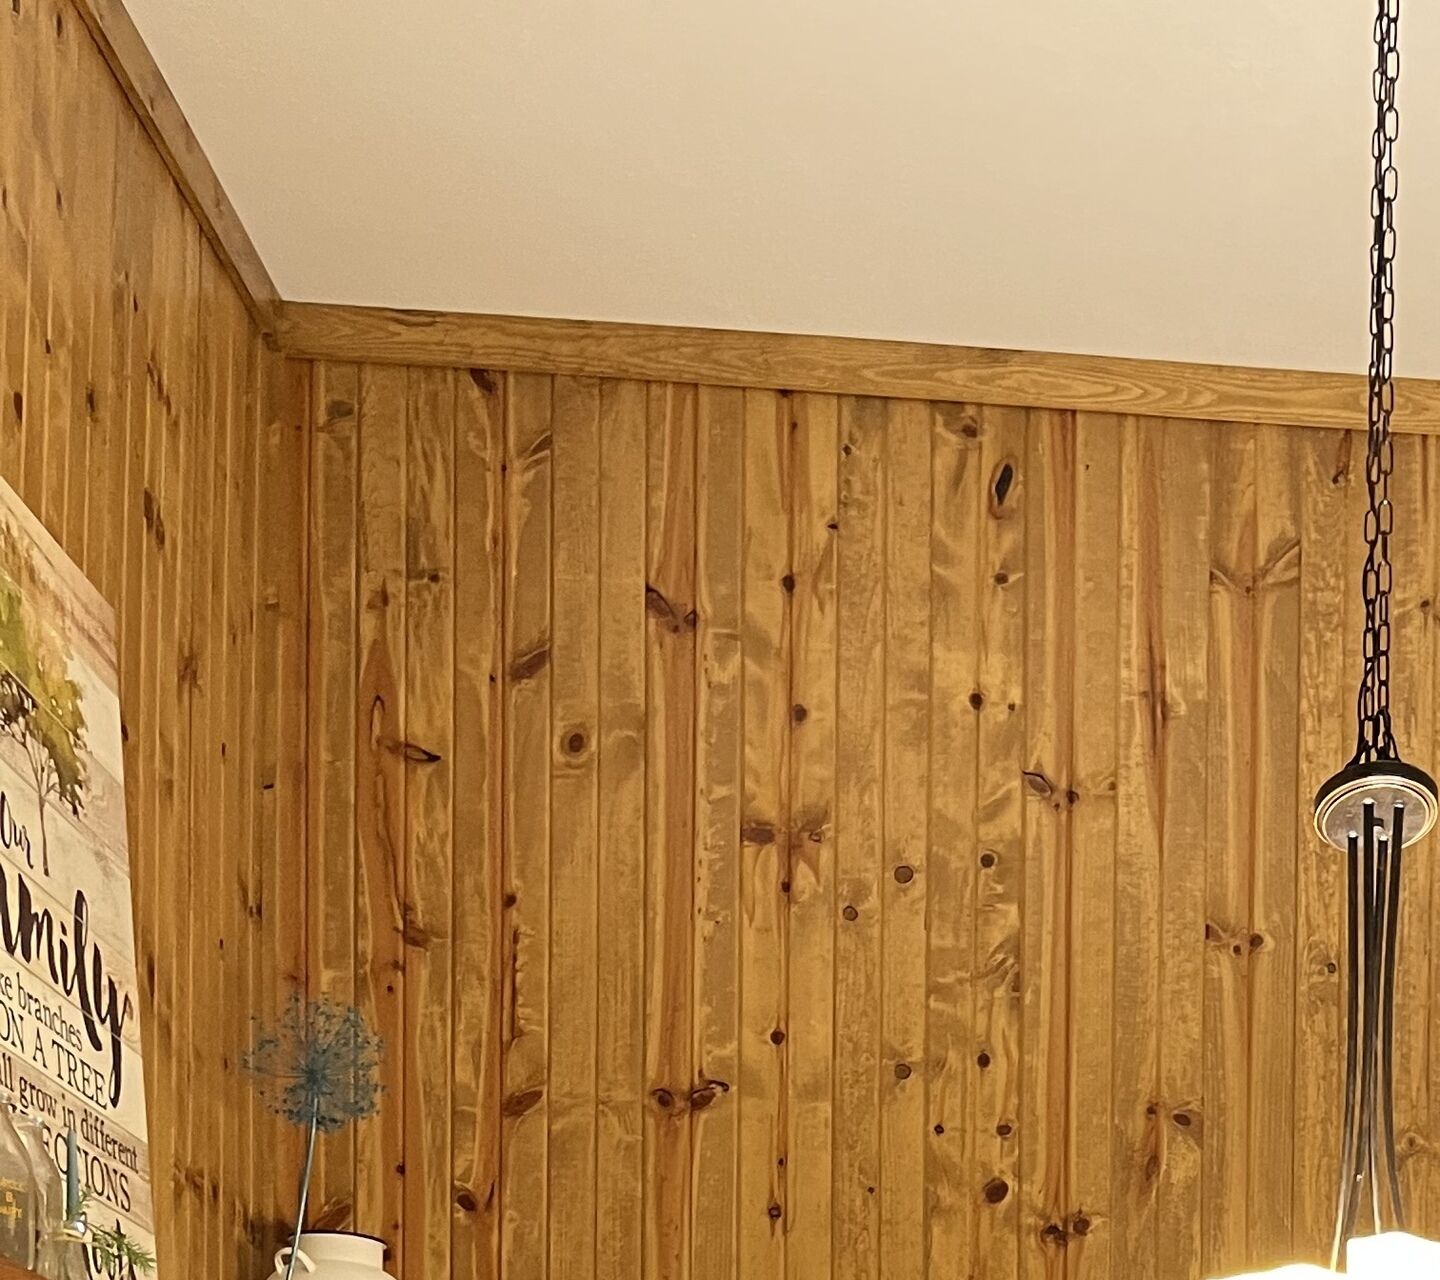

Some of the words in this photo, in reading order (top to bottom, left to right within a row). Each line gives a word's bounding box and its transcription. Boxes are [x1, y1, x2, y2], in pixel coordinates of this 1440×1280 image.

[16, 972, 82, 1052] branches
[33, 1028, 48, 1069] A
[52, 1039, 108, 1111] TREE
[19, 1076, 57, 1119] grow
[62, 1093, 76, 1133] in
[81, 1107, 138, 1174] different
